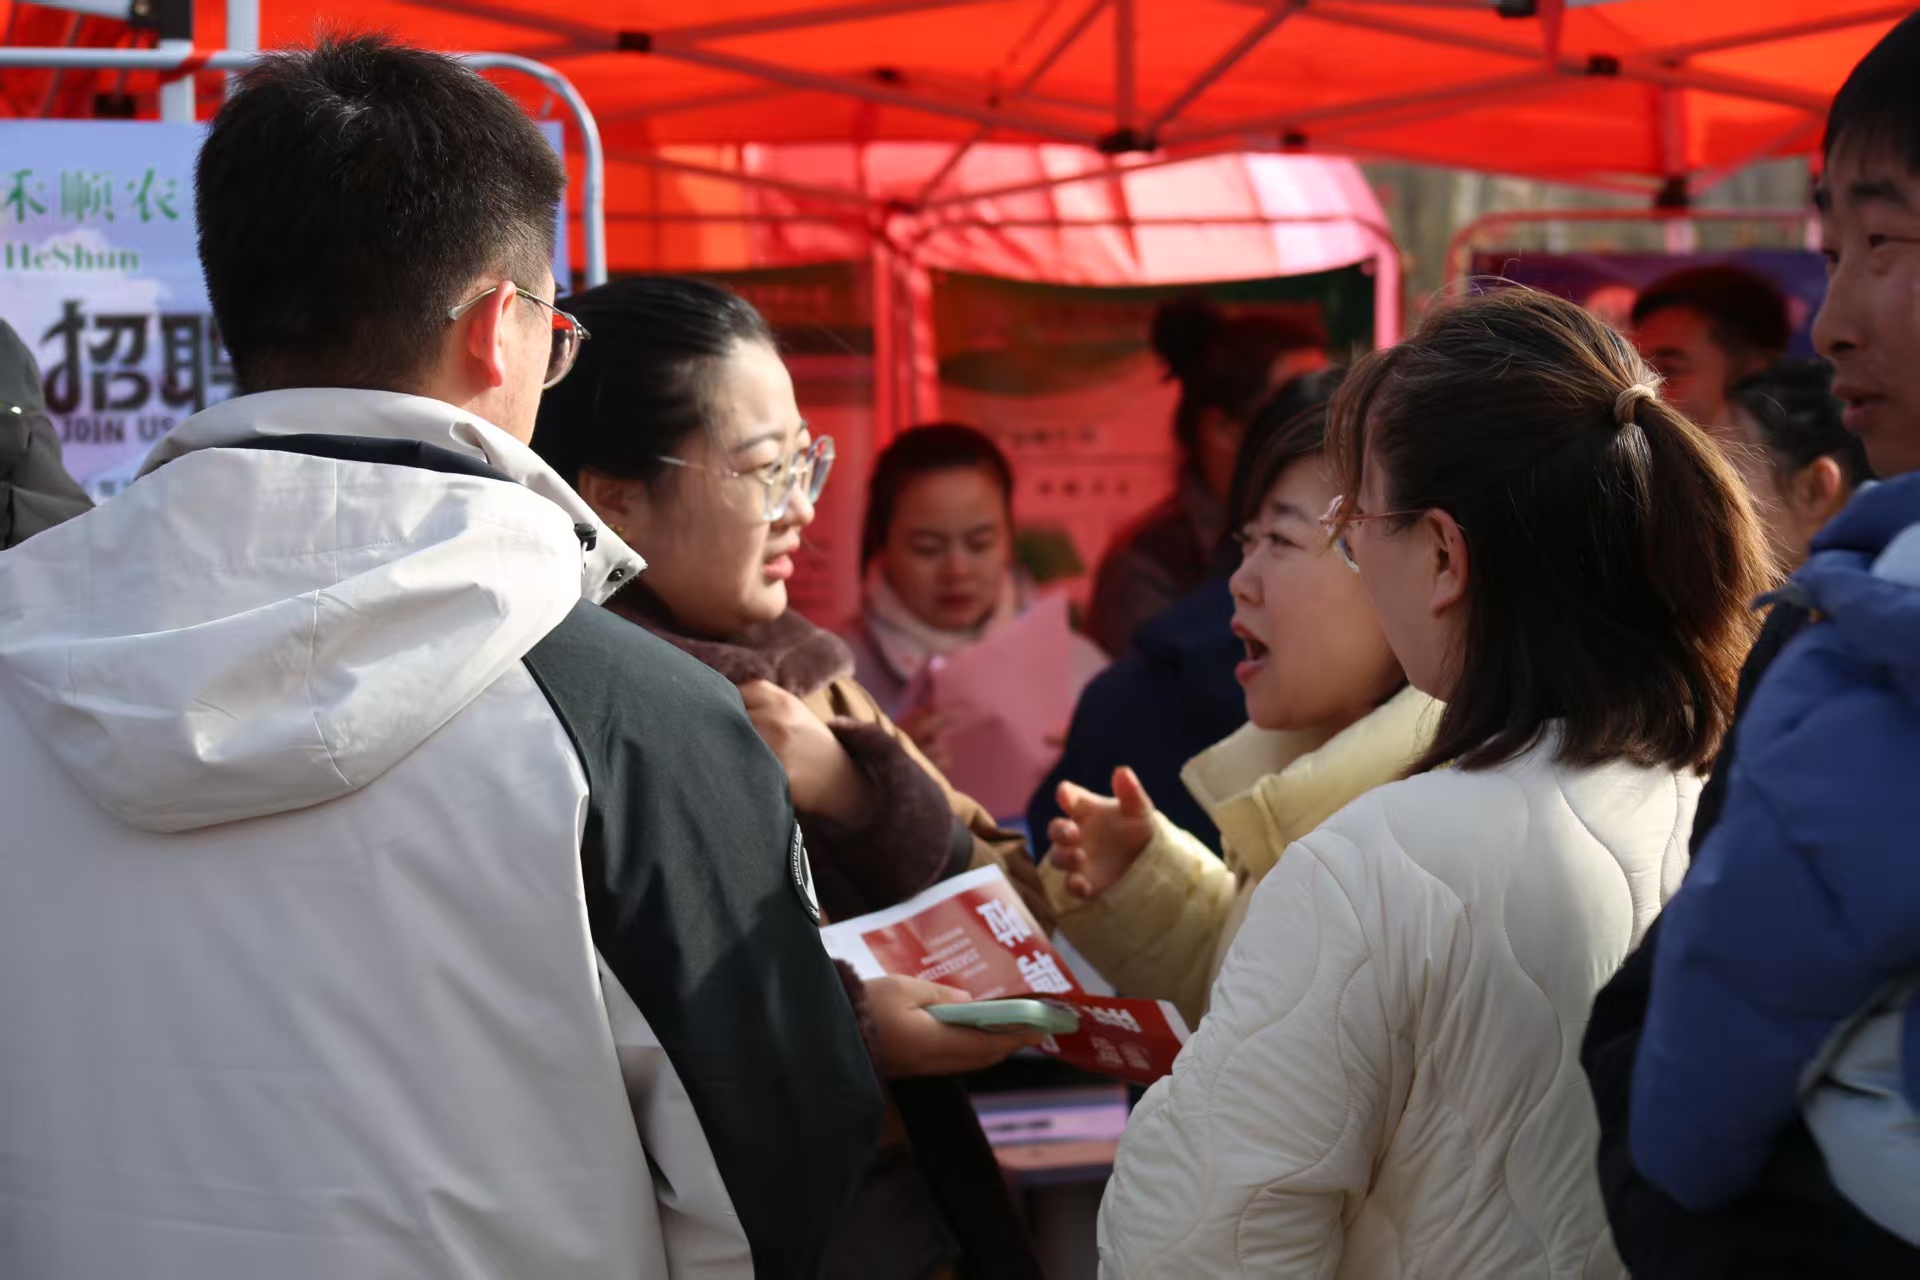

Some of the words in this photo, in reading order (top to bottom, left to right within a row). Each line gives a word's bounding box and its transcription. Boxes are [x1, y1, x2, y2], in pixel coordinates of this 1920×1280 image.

[2, 167, 180, 225] 禾顺农
[5, 241, 140, 270] HeShun
[62, 416, 124, 444] JOIN
[793, 843, 802, 885] MOUNTAIN
